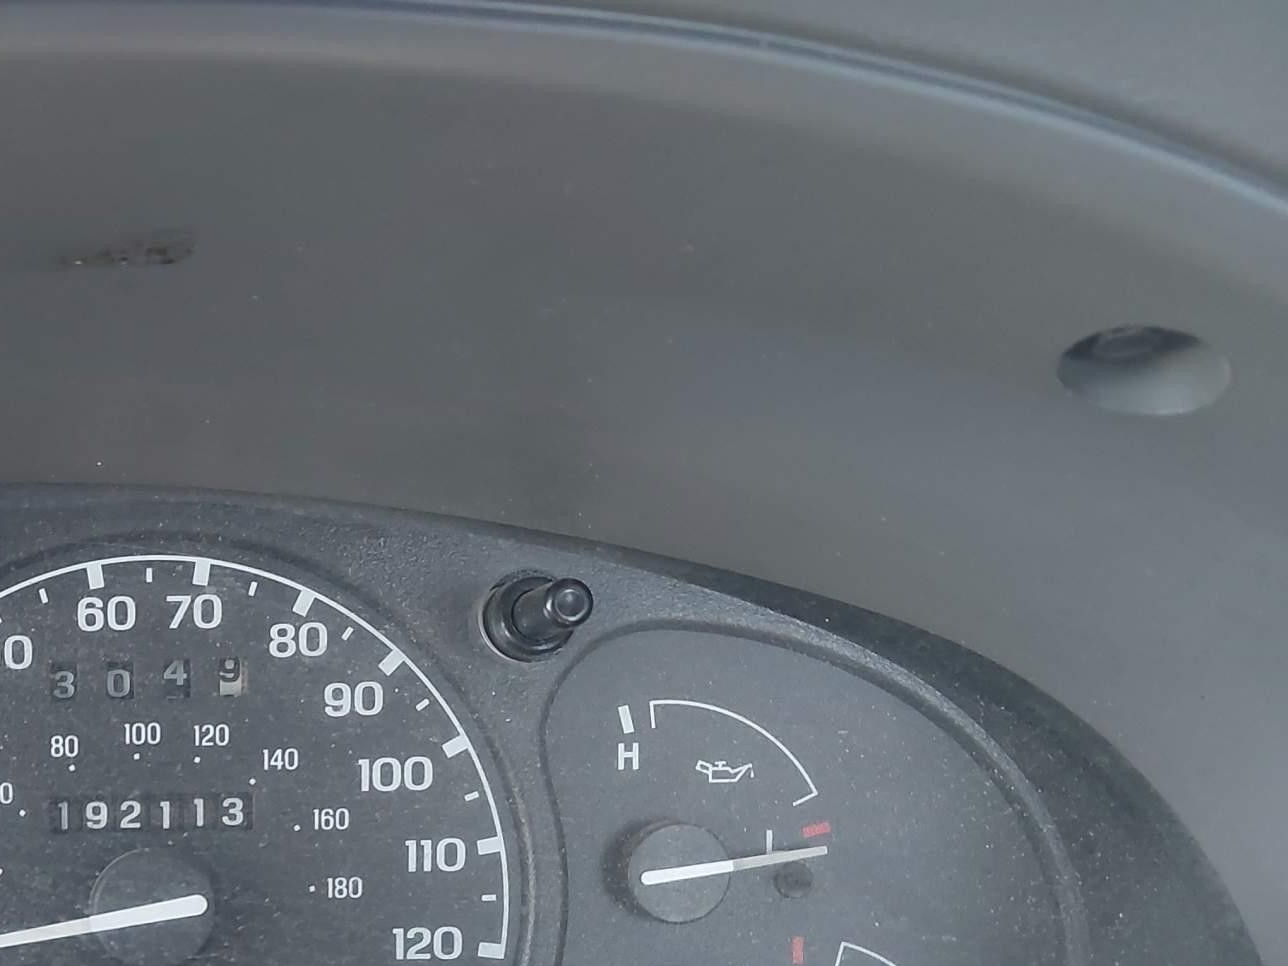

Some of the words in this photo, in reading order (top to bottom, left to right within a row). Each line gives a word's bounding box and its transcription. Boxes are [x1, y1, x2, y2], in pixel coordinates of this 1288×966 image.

[77, 596, 136, 632] 60
[166, 594, 223, 629] 70
[268, 622, 328, 658] 80
[324, 681, 384, 717] 90
[50, 735, 79, 758] 80
[124, 722, 161, 745] 100
[193, 724, 230, 747] 120
[262, 748, 299, 771] 140
[618, 743, 639, 770] H
[358, 756, 433, 792] 100
[58, 797, 245, 831] 192113
[312, 808, 350, 831] 160
[405, 837, 466, 873] 110
[327, 877, 363, 900] 180
[392, 927, 463, 960] 120
